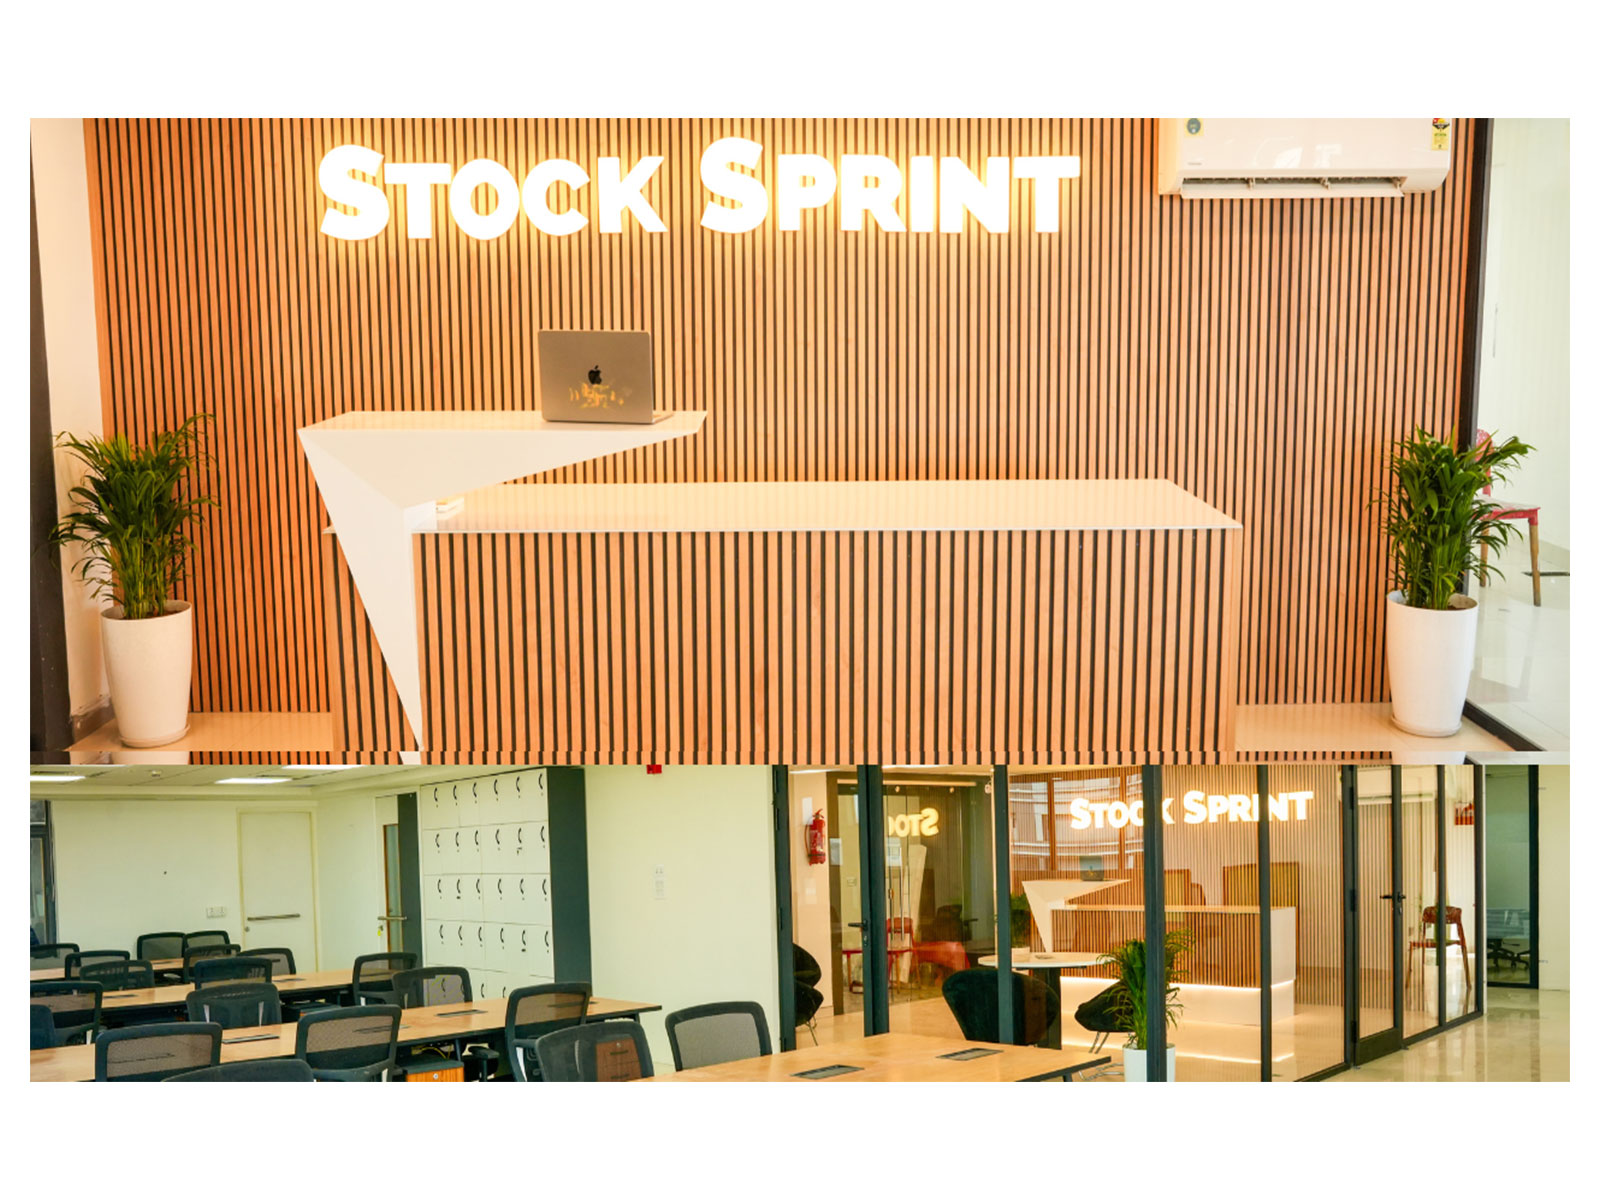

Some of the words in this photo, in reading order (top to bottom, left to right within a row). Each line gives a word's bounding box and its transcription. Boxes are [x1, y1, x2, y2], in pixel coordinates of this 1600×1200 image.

[318, 144, 668, 241] STOCK
[699, 136, 1081, 234] SPRINT
[1183, 790, 1314, 824] SPRINT
